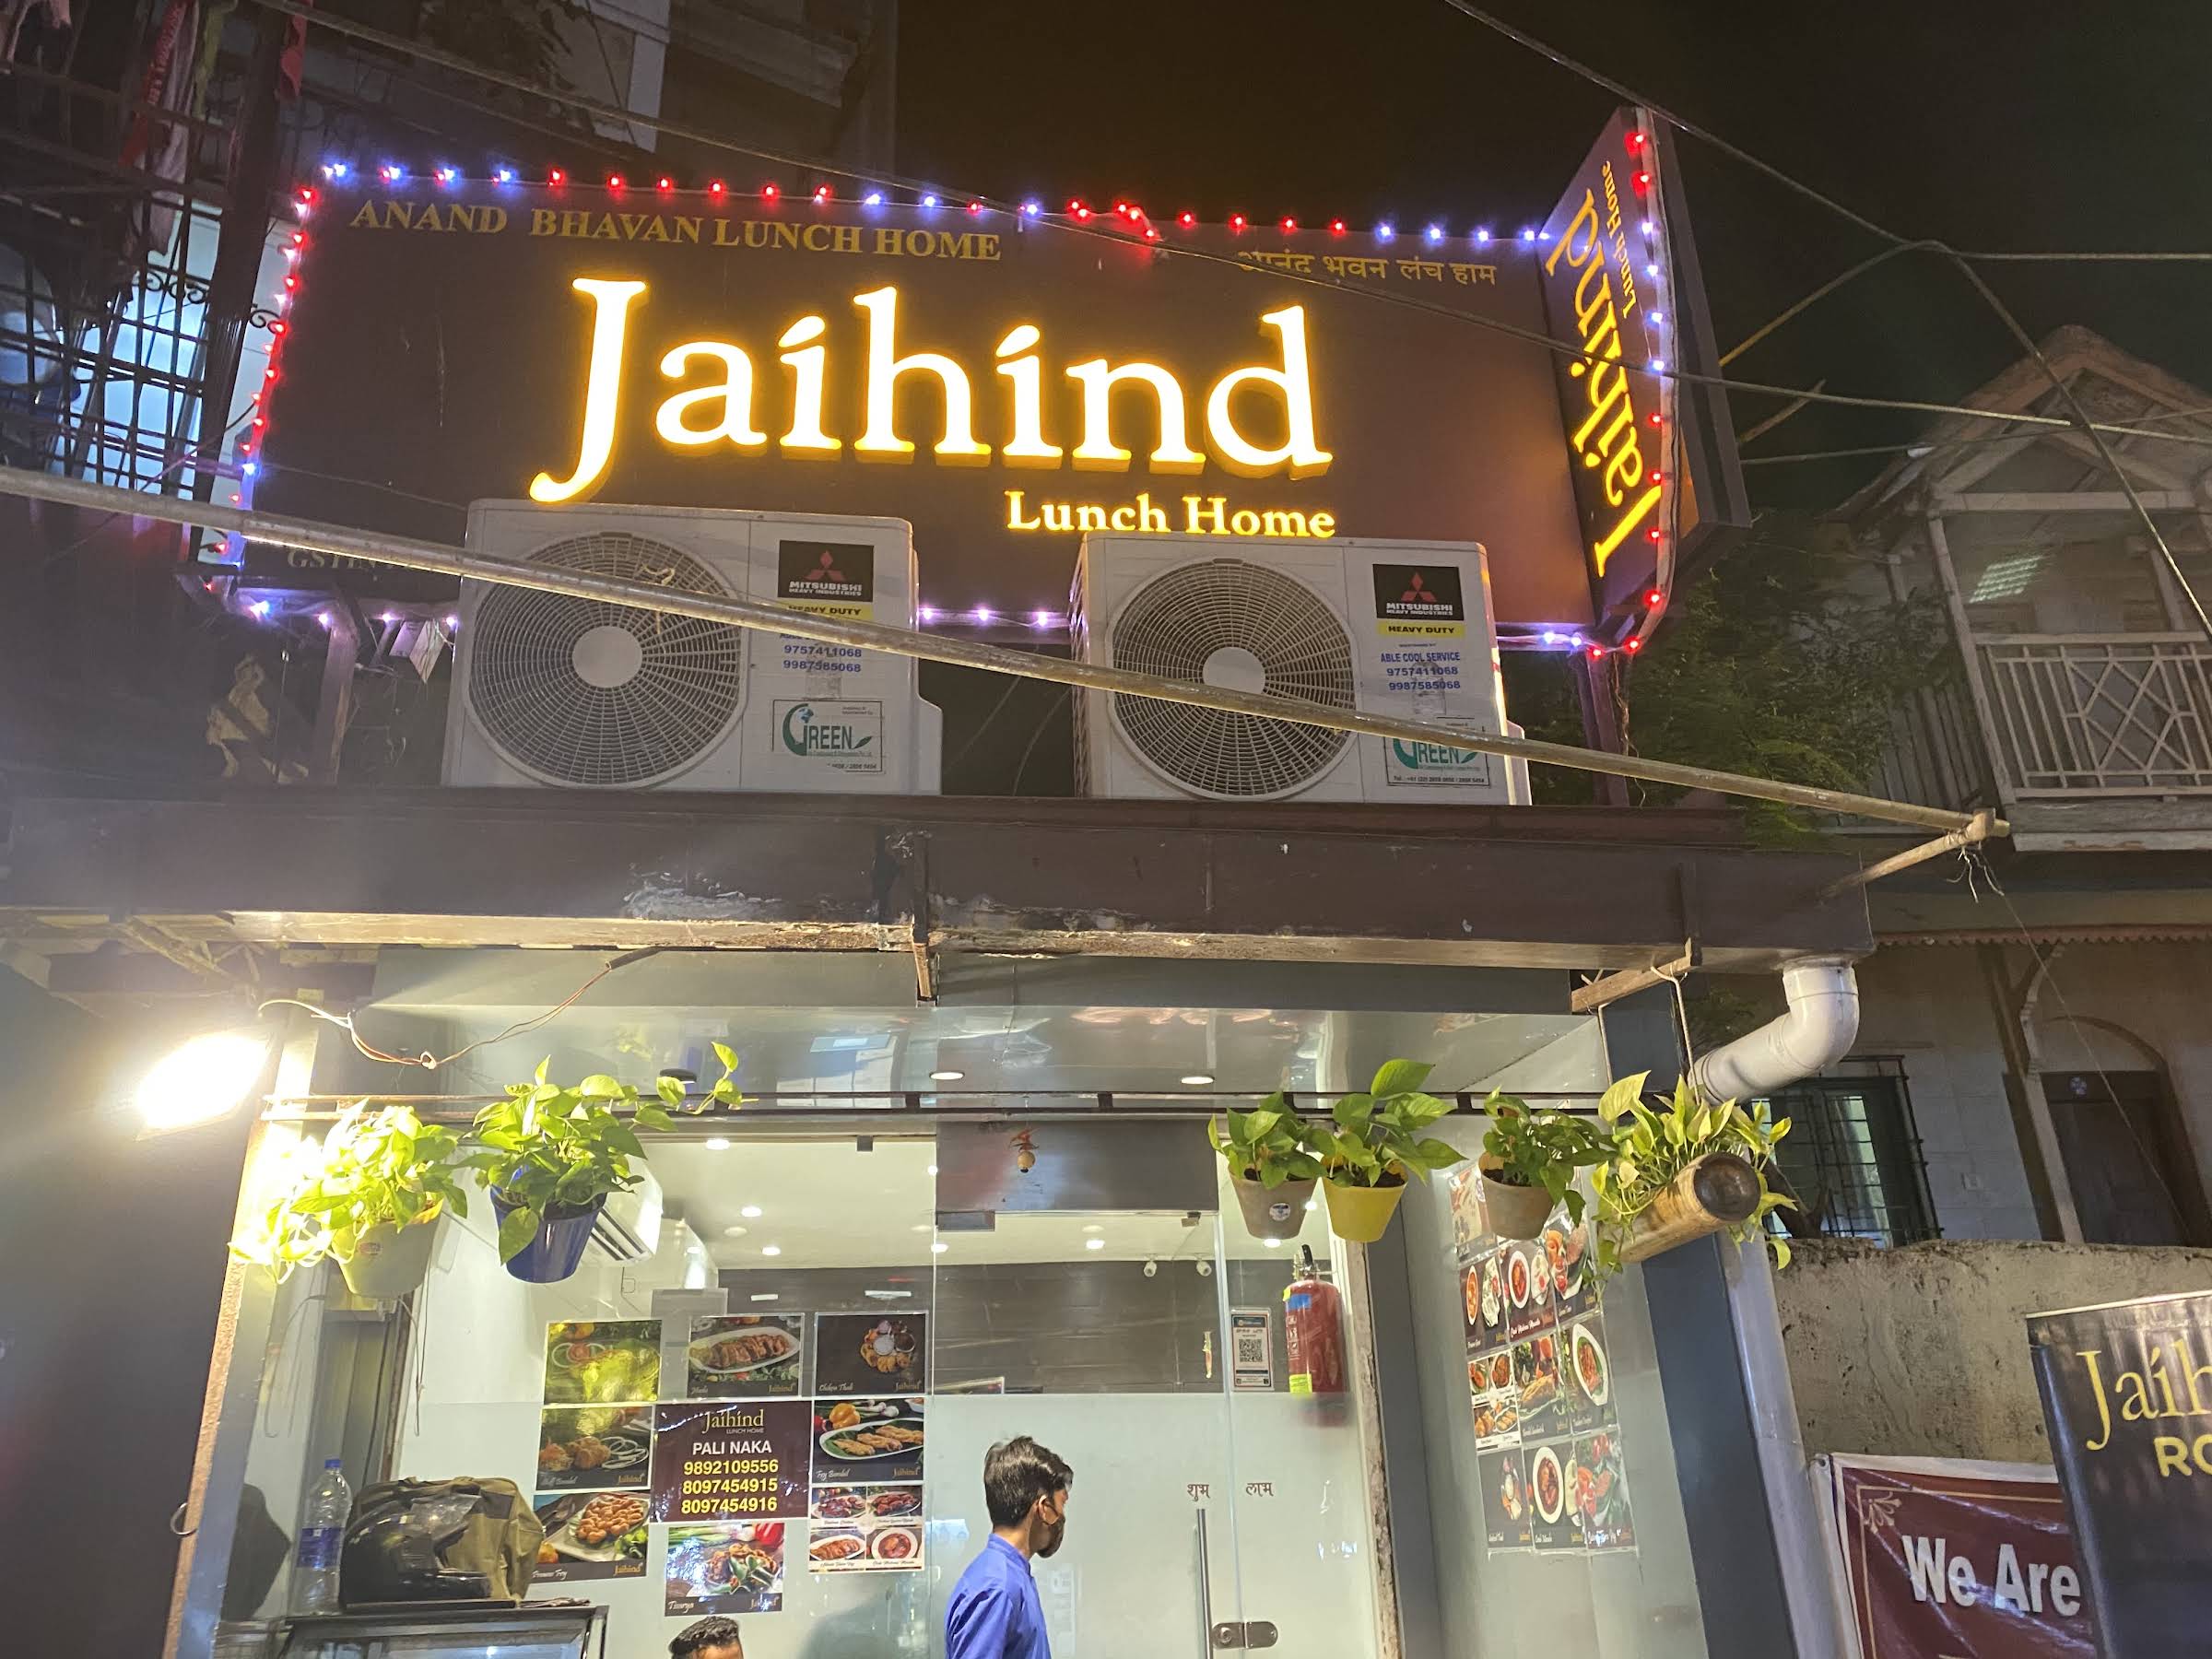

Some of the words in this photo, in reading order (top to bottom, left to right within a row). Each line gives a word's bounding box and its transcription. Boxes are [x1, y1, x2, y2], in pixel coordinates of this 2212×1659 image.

[1602, 159, 1622, 241] Home
[350, 199, 508, 234] ANAND
[530, 208, 703, 244] BHAVAN
[715, 218, 861, 253] LUNCH
[876, 229, 1001, 262] HOME
[1322, 254, 1389, 279] भवन
[1396, 256, 1444, 281] लंच
[1614, 230, 1637, 320] Lunch
[528, 276, 1333, 503] Jaihind
[1005, 490, 1171, 533] Lunch
[1181, 496, 1336, 538] Home
[789, 581, 863, 591] MITSUBISHI
[830, 606, 862, 616] DUTY
[1385, 602, 1453, 611] MITSUBISHI
[1426, 626, 1455, 634] DUTY
[783, 645, 863, 658] 9757411068
[1381, 653, 1401, 663] ABLE
[1402, 653, 1424, 663] COOL
[1426, 651, 1461, 662] SERVICE
[783, 660, 862, 673] 9987585068
[1386, 666, 1459, 677] 9757411068
[782, 703, 853, 756] GREEN
[702, 1409, 764, 1434] Jaihind
[692, 1441, 725, 1455] PALI
[730, 1440, 772, 1454] NAKA
[684, 1459, 779, 1475] 9892109556
[682, 1478, 778, 1494] 8097454915
[1186, 1484, 1210, 1501] शुभ
[1245, 1482, 1274, 1497] लाभ
[681, 1497, 778, 1514] 8097454916
[1901, 1535, 1978, 1606] We
[1994, 1543, 2081, 1618] Are
